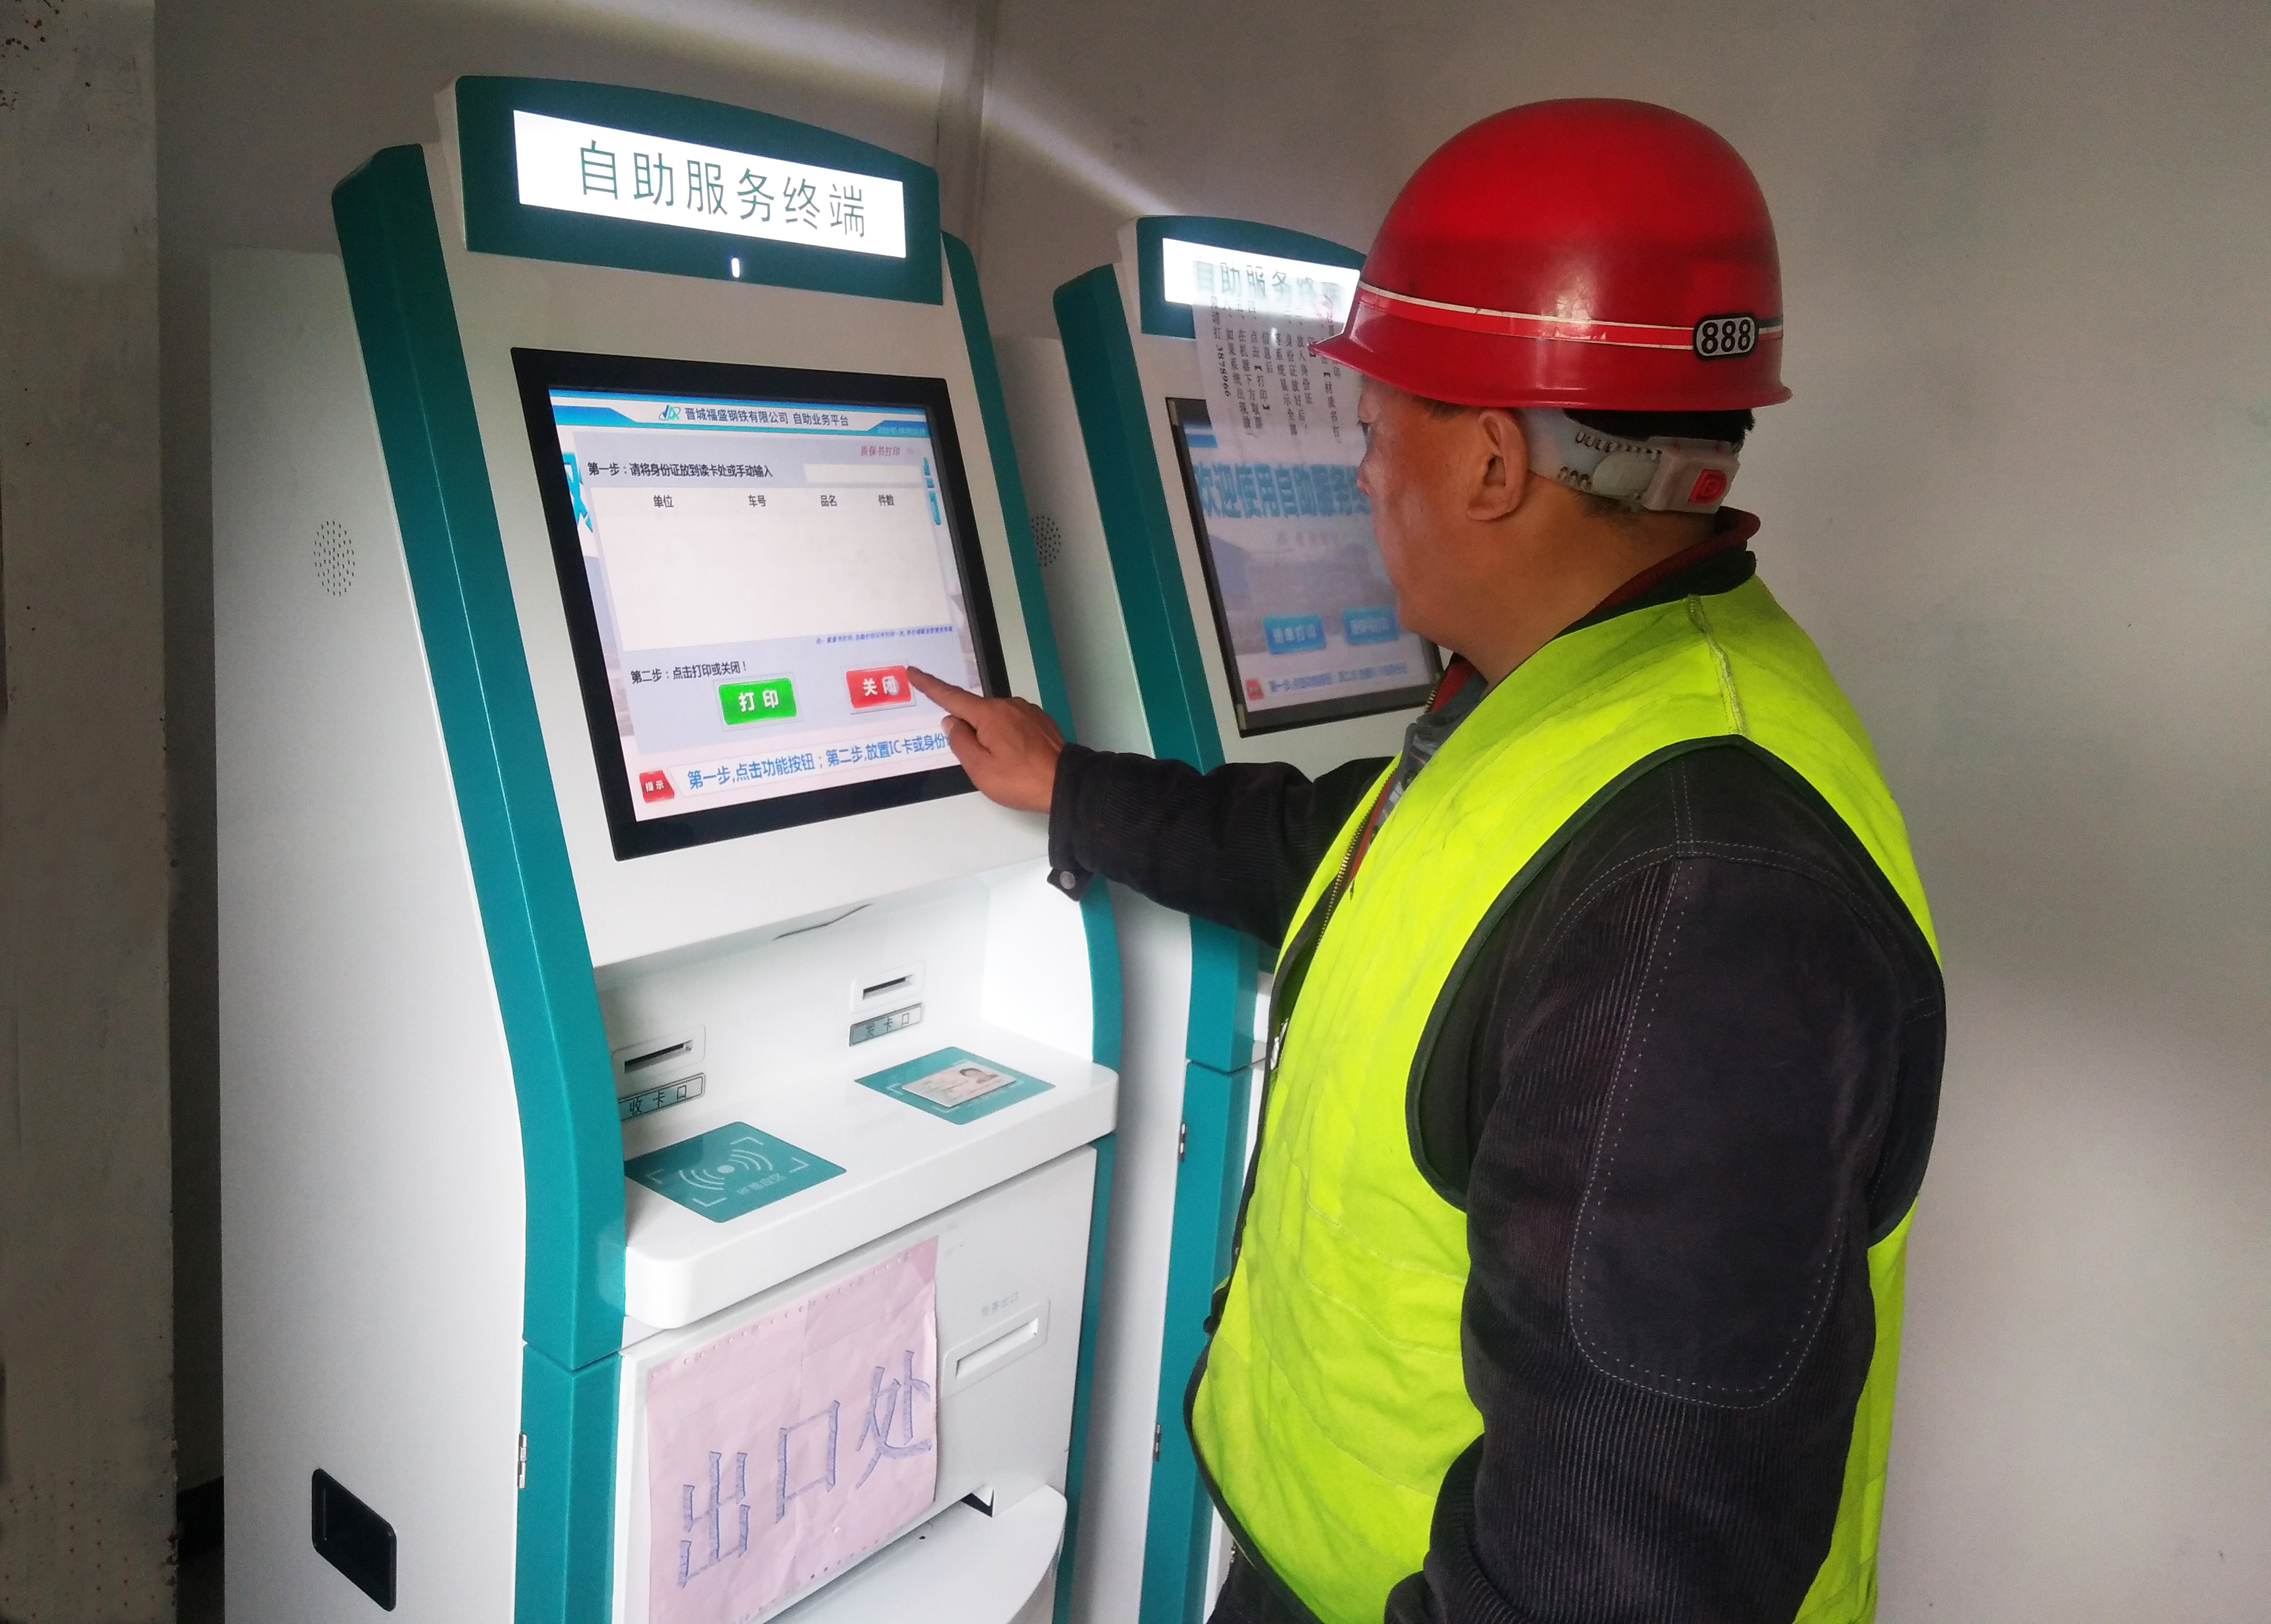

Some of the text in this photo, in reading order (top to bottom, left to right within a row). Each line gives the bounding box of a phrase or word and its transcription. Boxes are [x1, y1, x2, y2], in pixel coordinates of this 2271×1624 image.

[579, 140, 865, 238] 自助服务终端
[1196, 256, 1342, 307] 自助服务
[1701, 318, 1751, 354] 888
[684, 407, 850, 427] 晋城福盛钢铁有限公司 自助业务平台
[652, 494, 674, 508] 单位
[748, 495, 767, 507] 车号
[820, 494, 838, 507] 品名
[878, 494, 895, 507] 件数
[862, 675, 900, 696] 关闭
[738, 689, 780, 712] 打印
[866, 1012, 910, 1037] 发卡口
[629, 1084, 688, 1116] 收卡口
[678, 1349, 933, 1589] 出口处
